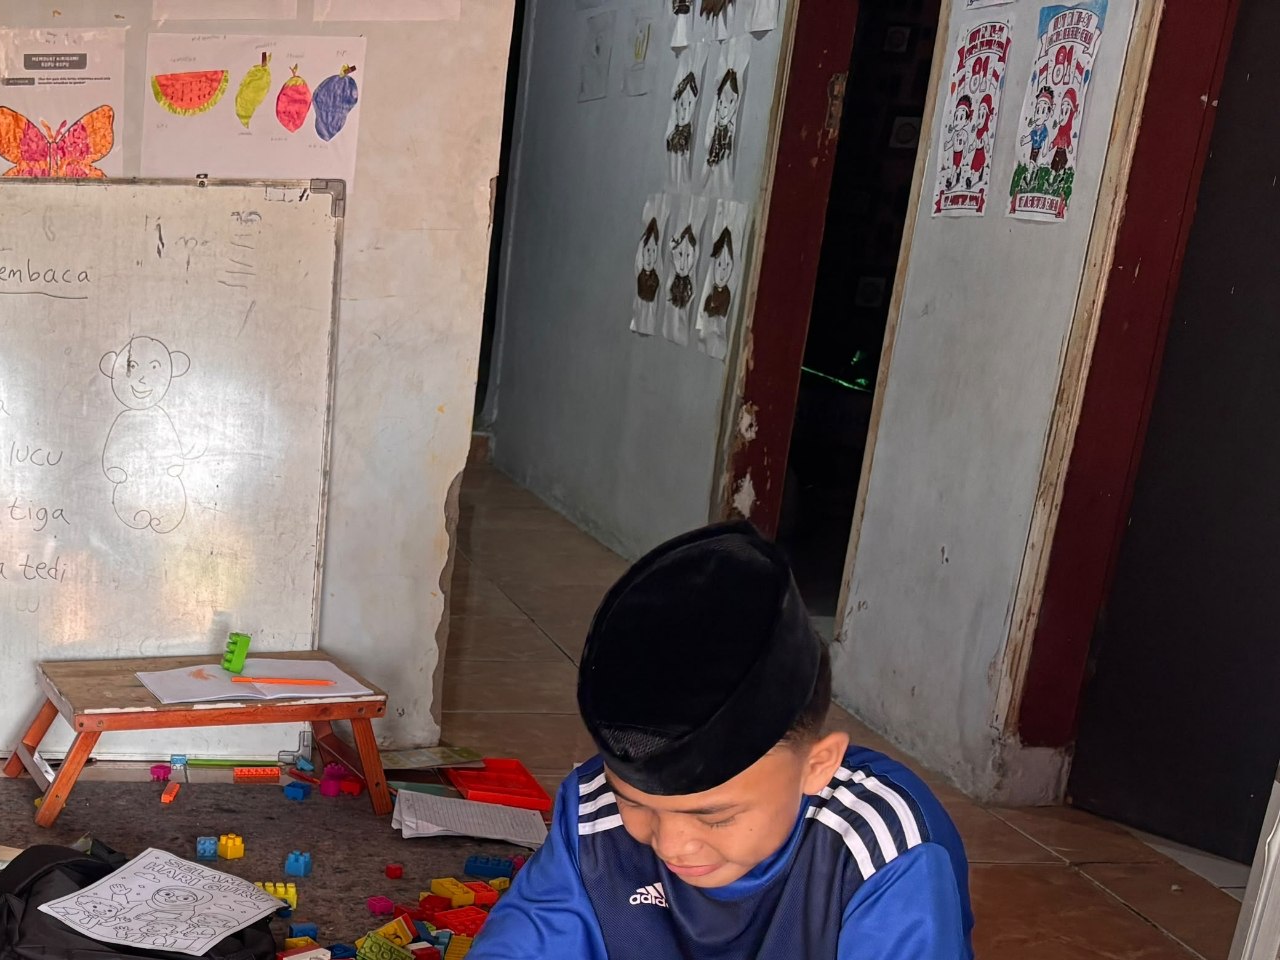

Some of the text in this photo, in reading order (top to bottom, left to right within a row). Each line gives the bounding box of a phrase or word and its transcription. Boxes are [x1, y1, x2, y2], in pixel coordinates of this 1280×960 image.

[7, 497, 71, 532] tiga
[17, 553, 68, 584] tedi
[143, 861, 201, 887] HARI
[202, 882, 269, 903] GURU
[628, 892, 669, 908] adid
